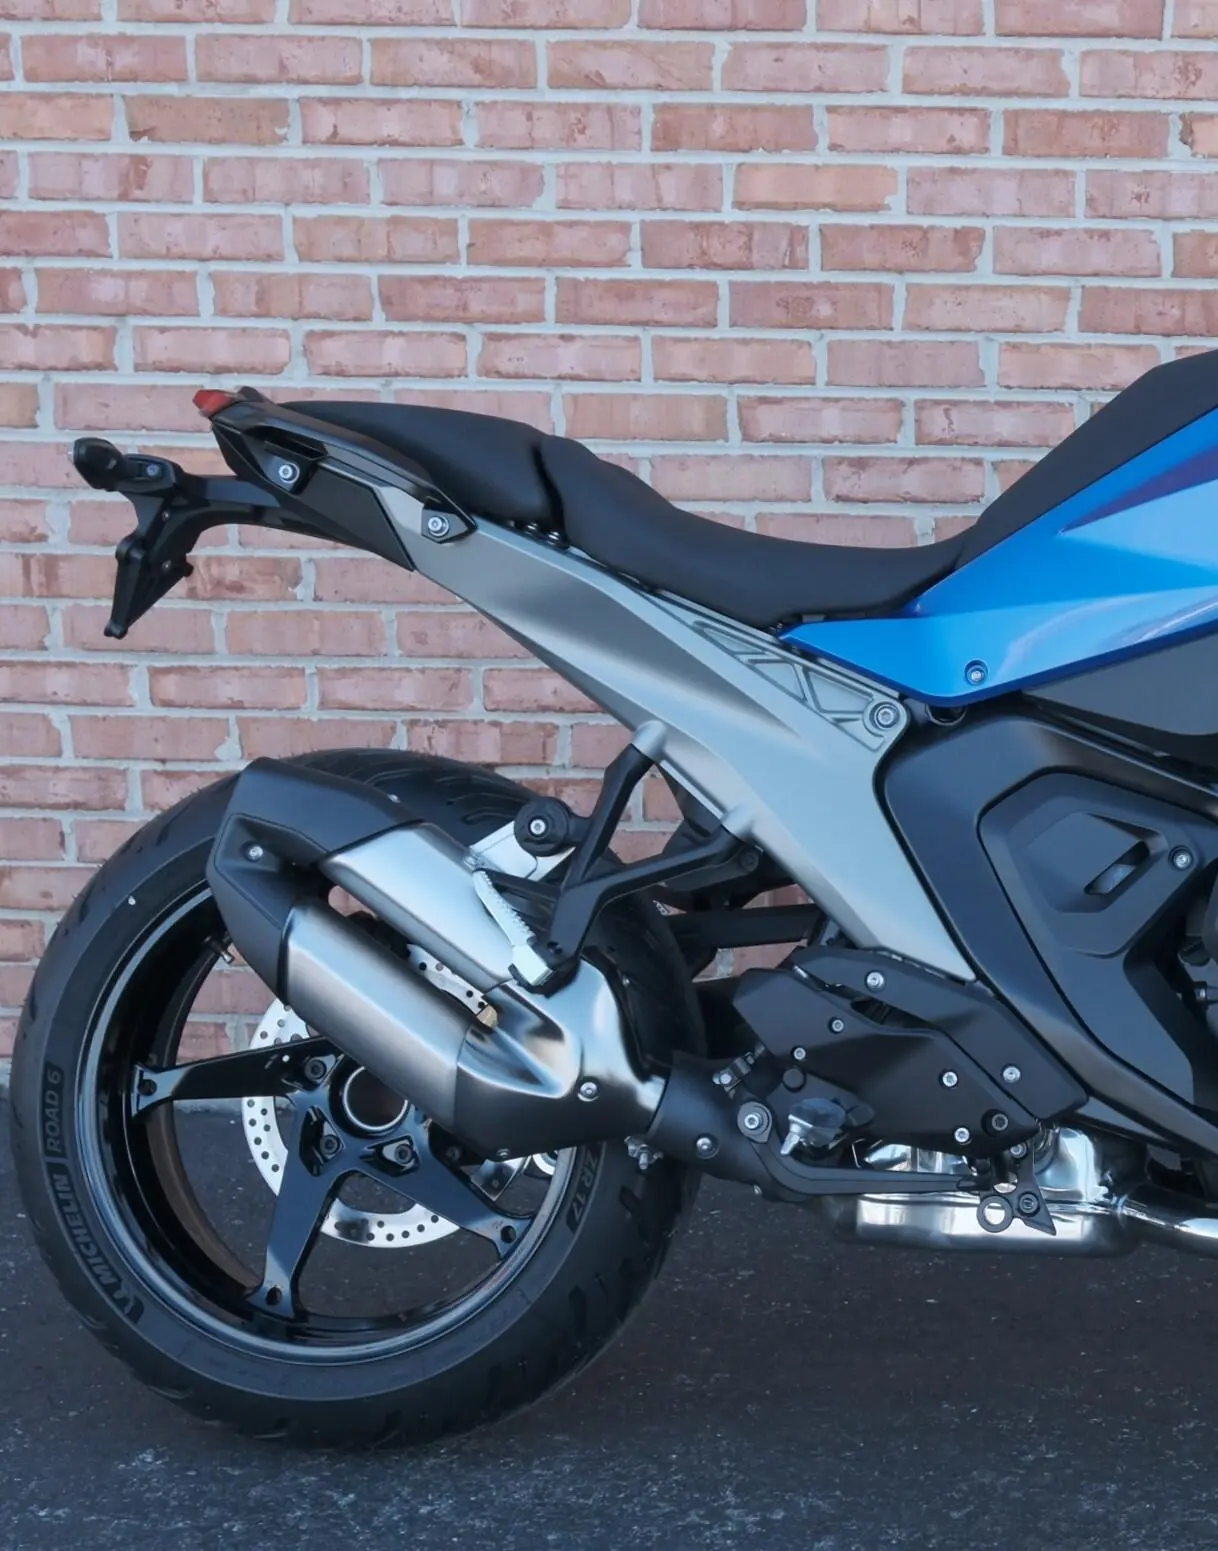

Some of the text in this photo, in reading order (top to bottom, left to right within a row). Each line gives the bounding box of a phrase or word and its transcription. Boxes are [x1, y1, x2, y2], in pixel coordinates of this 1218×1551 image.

[46, 1069, 119, 1286] MICHELIN ROAD 6
